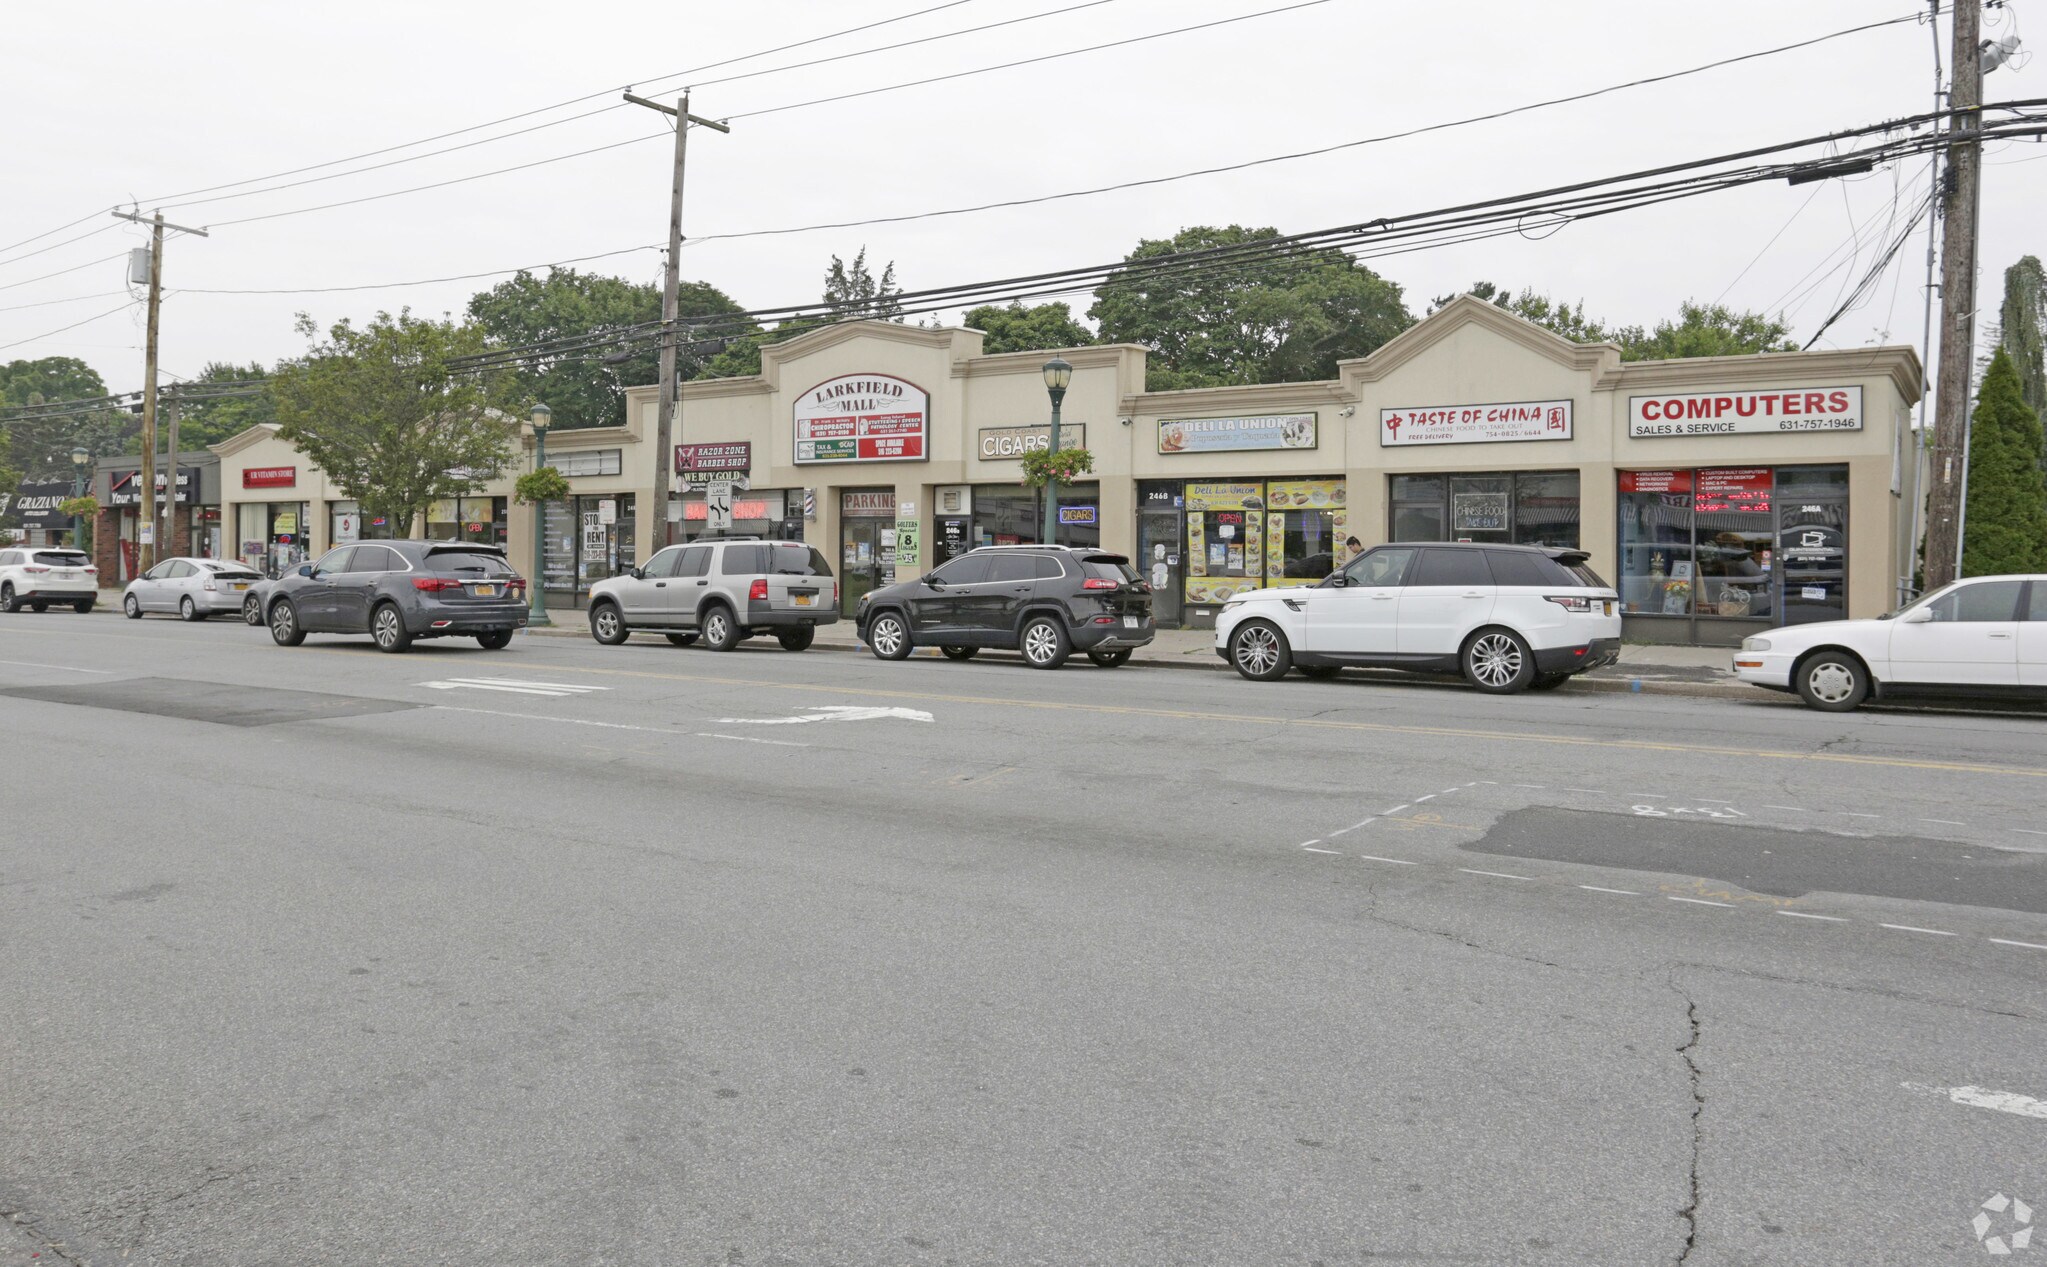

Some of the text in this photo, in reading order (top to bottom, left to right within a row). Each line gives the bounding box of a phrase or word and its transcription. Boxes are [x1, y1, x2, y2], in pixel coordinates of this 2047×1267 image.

[816, 381, 903, 403] LARKFIELD
[841, 399, 876, 412] MALL
[1641, 391, 1849, 421] COMPUTERS
[1409, 407, 1542, 427] TASTE OF CHINA
[811, 423, 854, 431] CHIROPRACTOR
[1184, 421, 1214, 432] DELI
[1219, 420, 1235, 431] LA
[1239, 418, 1287, 430] UNION
[1386, 413, 1403, 441] 中
[1426, 425, 1454, 433] CHINESE
[1636, 422, 1735, 435] SALES & SERVICE
[1779, 418, 1855, 430] 631-757-1946
[698, 446, 746, 456] RAZOR ZONE
[982, 435, 1049, 456] CIGARS
[697, 458, 747, 467] BARBER SHOP
[684, 471, 740, 481] WE BUY GOLD
[1194, 485, 1256, 495] Deli La Union
[112, 493, 130, 504] Your
[845, 494, 896, 508] PARKING
[734, 502, 765, 518] SHOP
[1062, 509, 1093, 520] CIGARS
[1456, 506, 1504, 516] CHINESE FOOD
[1802, 505, 1821, 513] 246A
[584, 514, 606, 526] STO
[1218, 513, 1243, 523] OPEN
[587, 531, 605, 543] RENT
[904, 535, 912, 545] 8
